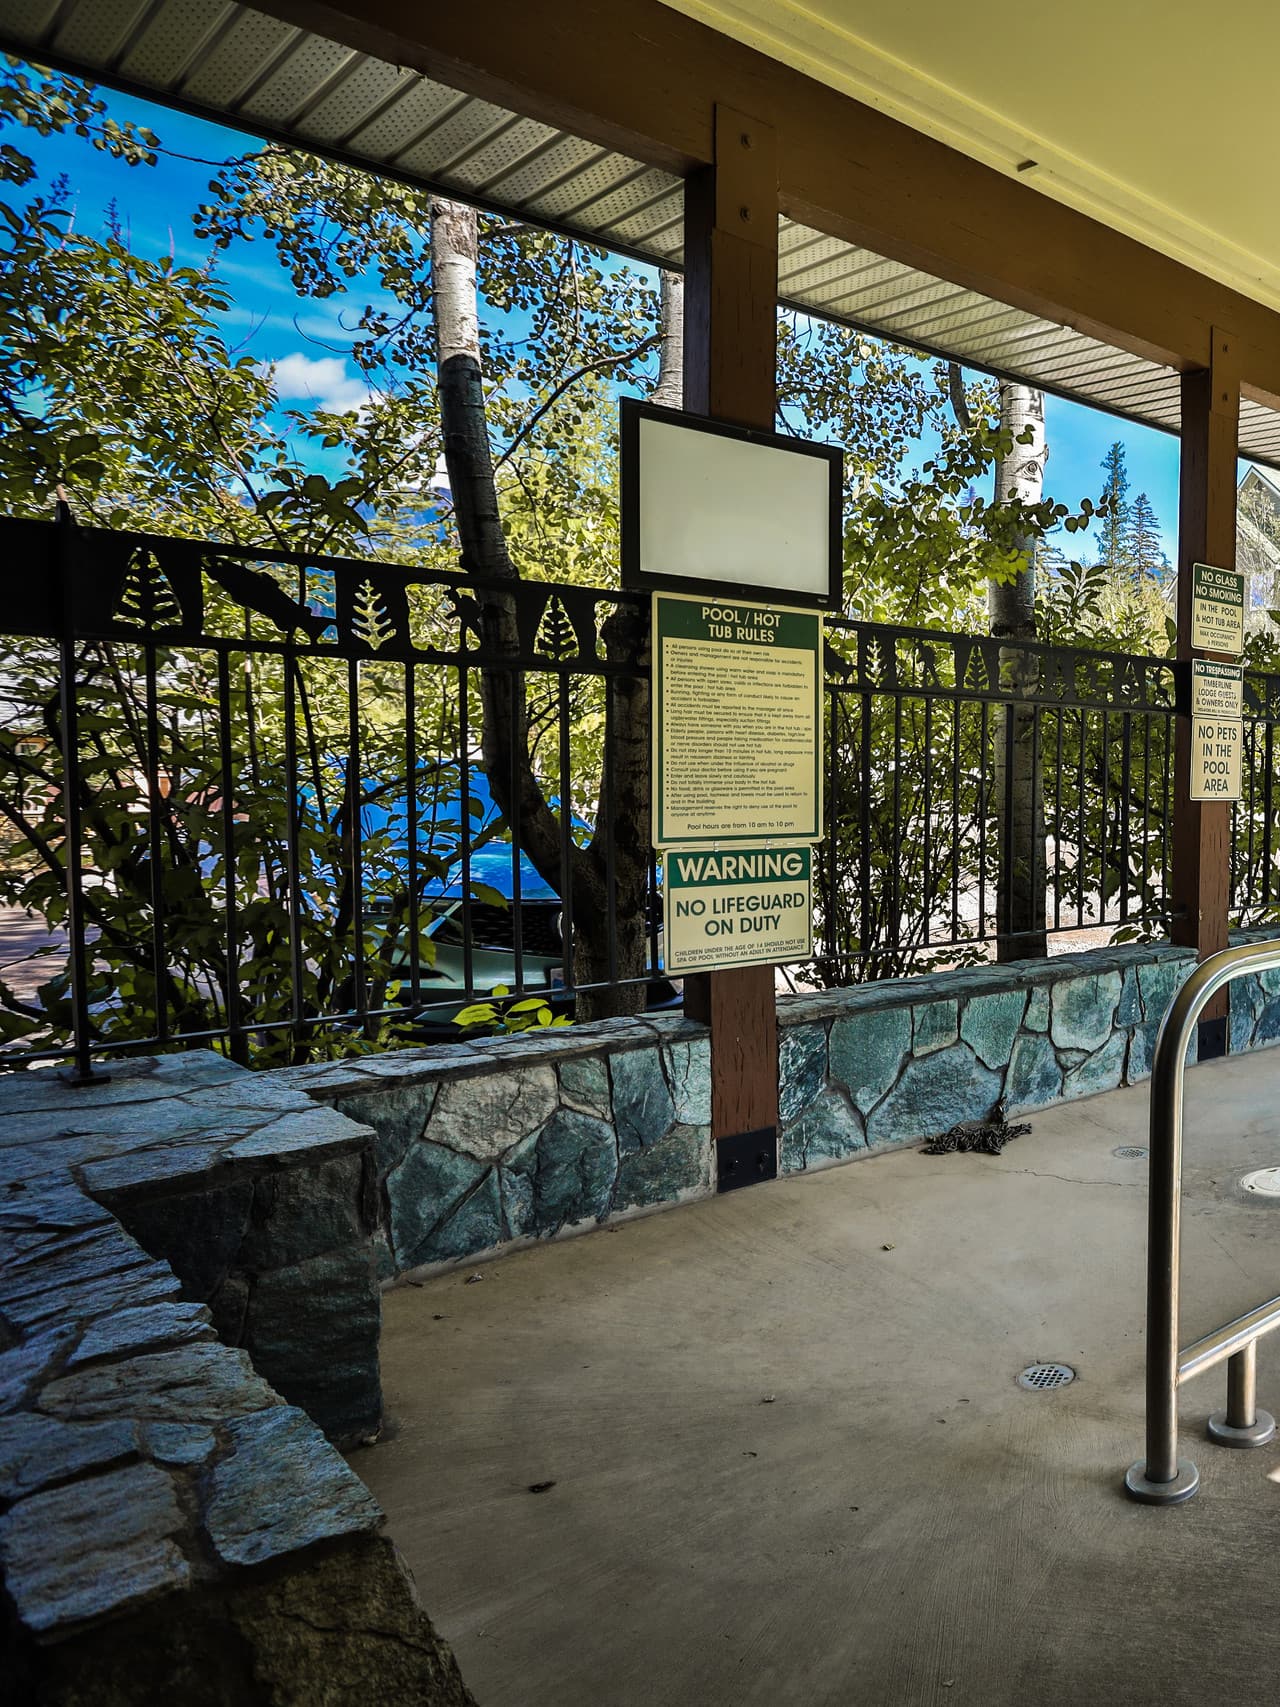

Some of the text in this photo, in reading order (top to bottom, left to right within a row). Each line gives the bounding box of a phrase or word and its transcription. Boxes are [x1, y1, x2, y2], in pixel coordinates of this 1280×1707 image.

[1202, 571, 1237, 587] NO GLASS
[1196, 585, 1242, 603] NO SMOKING
[1200, 603, 1237, 617] IN THE POOL
[702, 607, 781, 628] POOL / HOT
[1196, 614, 1241, 629] & HOT TUB AREA
[708, 623, 775, 643] TUB RULES
[1210, 632, 1235, 641] OCCUPANCY
[1195, 663, 1241, 677] NO TRESPASSING
[1203, 679, 1232, 689] TIMBERLINE
[1198, 688, 1236, 699] LODGE GUESTS
[1201, 698, 1223, 707] OWNERS
[1225, 699, 1239, 710] ONLY
[1198, 726, 1237, 741] NO PETS
[1203, 744, 1232, 757] IN THE
[1203, 761, 1230, 774] POOL
[1203, 779, 1228, 792] AREA
[677, 853, 803, 882] WARNING
[676, 892, 805, 917] NO LIFEGUARD
[705, 915, 781, 936] ON DUTY
[675, 949, 703, 957] CHILDREN
[716, 951, 739, 959] WITHOUT
